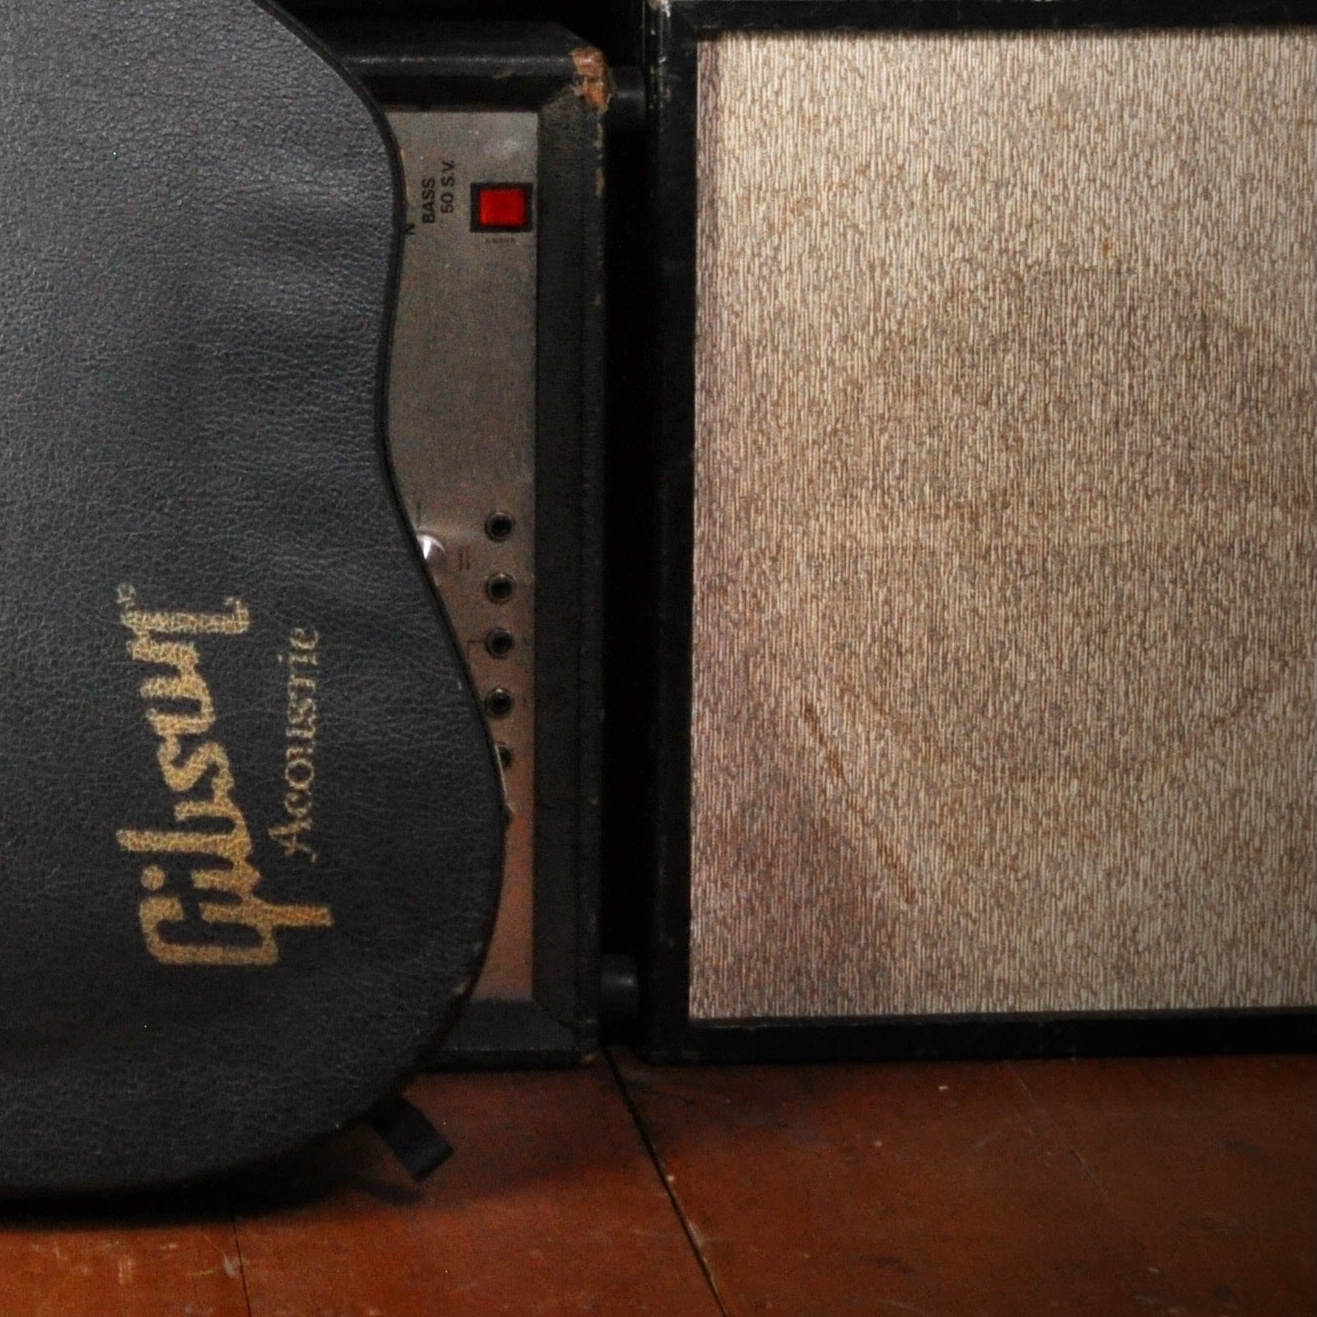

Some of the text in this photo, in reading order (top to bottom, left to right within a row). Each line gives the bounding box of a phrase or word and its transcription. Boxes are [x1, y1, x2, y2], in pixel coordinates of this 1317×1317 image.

[421, 177, 436, 224] BASS
[440, 192, 454, 214] 50
[116, 584, 334, 965] Gibson
[268, 626, 319, 864] Acoustic
